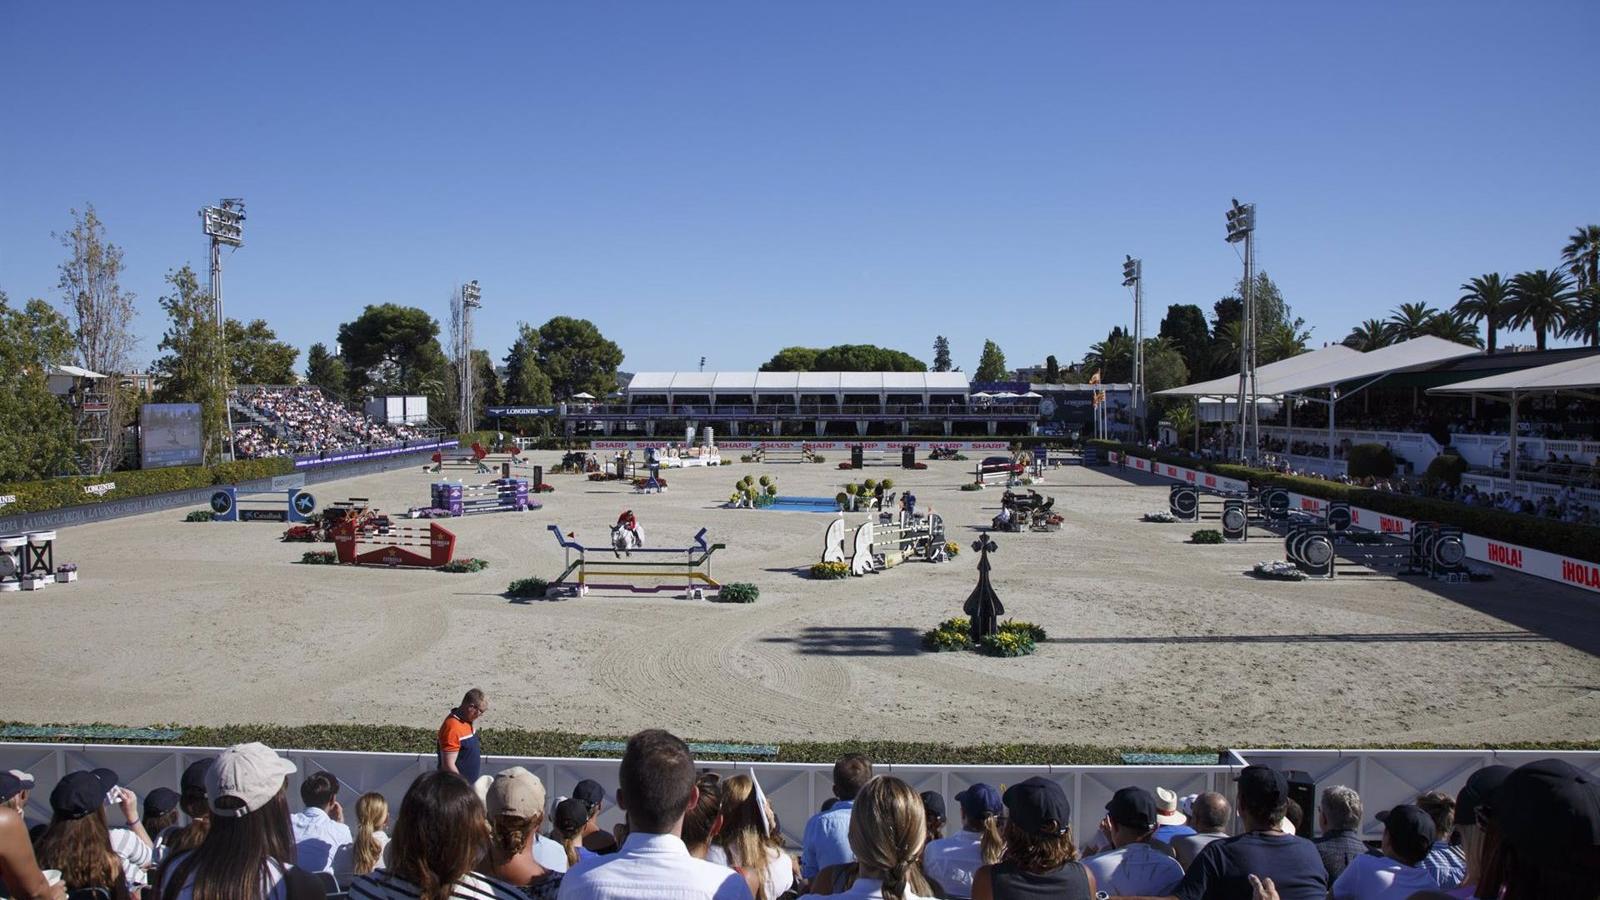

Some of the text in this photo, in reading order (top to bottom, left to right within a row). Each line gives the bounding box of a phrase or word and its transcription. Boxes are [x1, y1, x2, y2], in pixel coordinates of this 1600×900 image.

[84, 482, 115, 494] LONGINES
[33, 510, 84, 526] VANGUARDIA
[1488, 542, 1522, 568] ¡HOLA!
